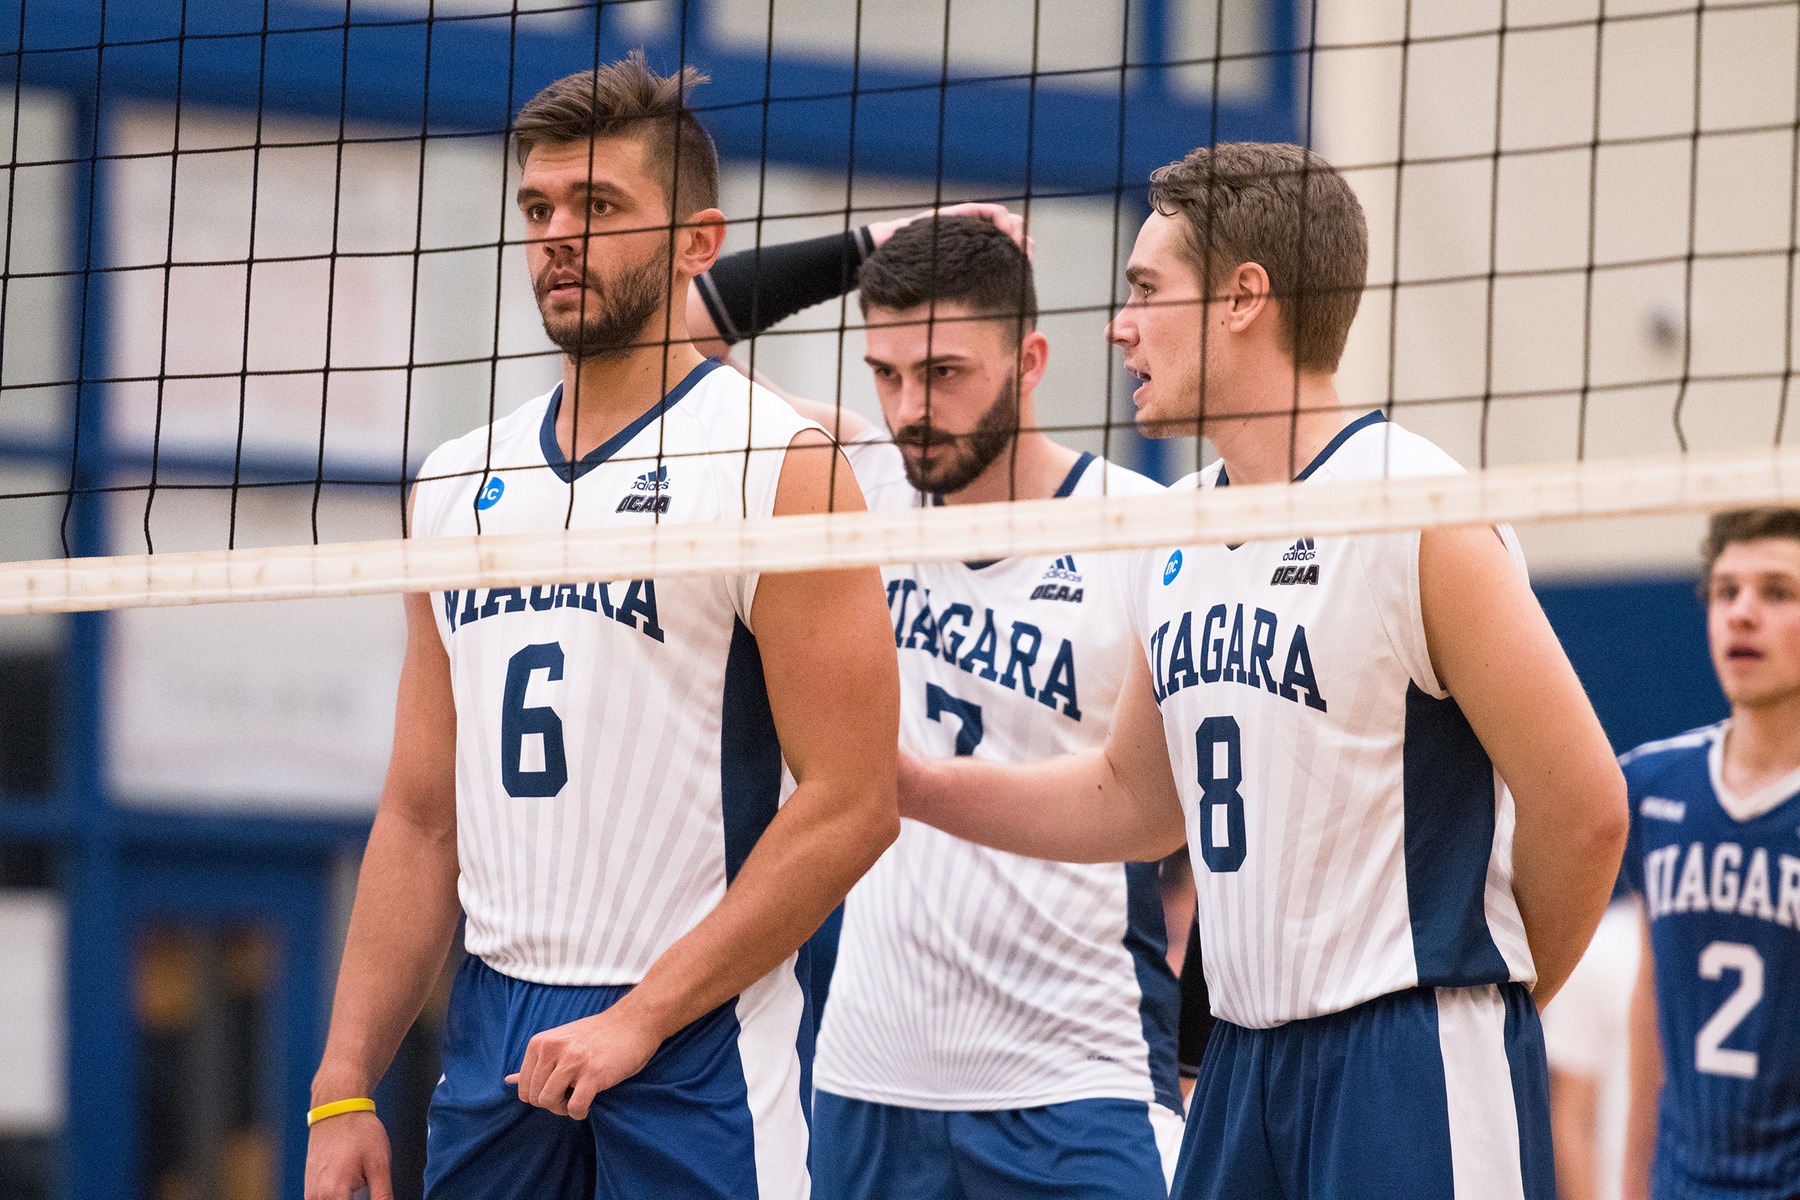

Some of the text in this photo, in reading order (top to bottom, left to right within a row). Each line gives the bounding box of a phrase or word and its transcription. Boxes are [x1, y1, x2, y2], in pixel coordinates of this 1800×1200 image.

[615, 494, 672, 514] OCAA
[1029, 583, 1083, 603] OCAA
[1270, 564, 1320, 586] OCAA
[1283, 549, 1316, 561] adidas
[887, 578, 1082, 722] IAGARA
[502, 641, 569, 798] 6
[926, 681, 984, 757] 7
[1195, 715, 1247, 873] 8
[1694, 940, 1764, 1079] 2
